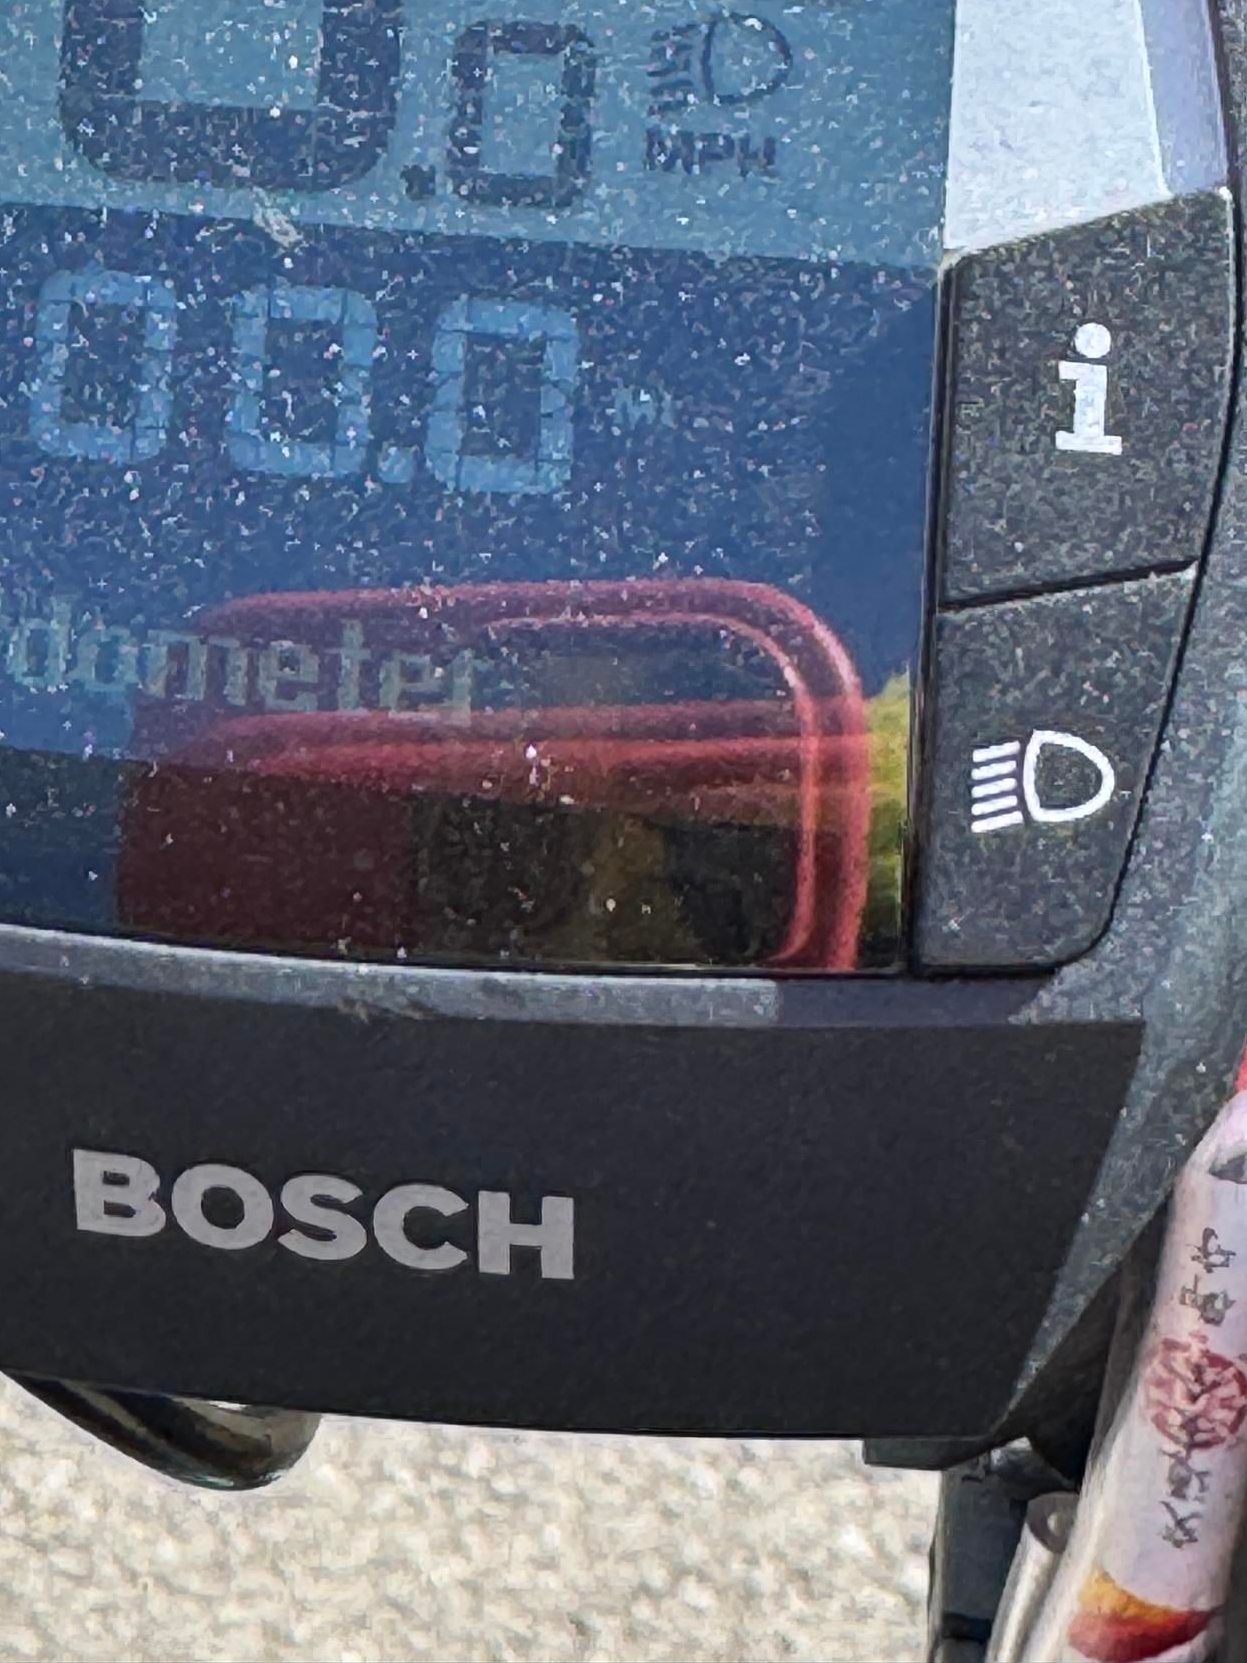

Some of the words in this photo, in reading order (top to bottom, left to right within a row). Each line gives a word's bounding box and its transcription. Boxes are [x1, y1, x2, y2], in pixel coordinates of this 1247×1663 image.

[643, 128, 777, 179] MPH
[1055, 322, 1123, 456] i
[72, 1147, 577, 1280] BOSCH
